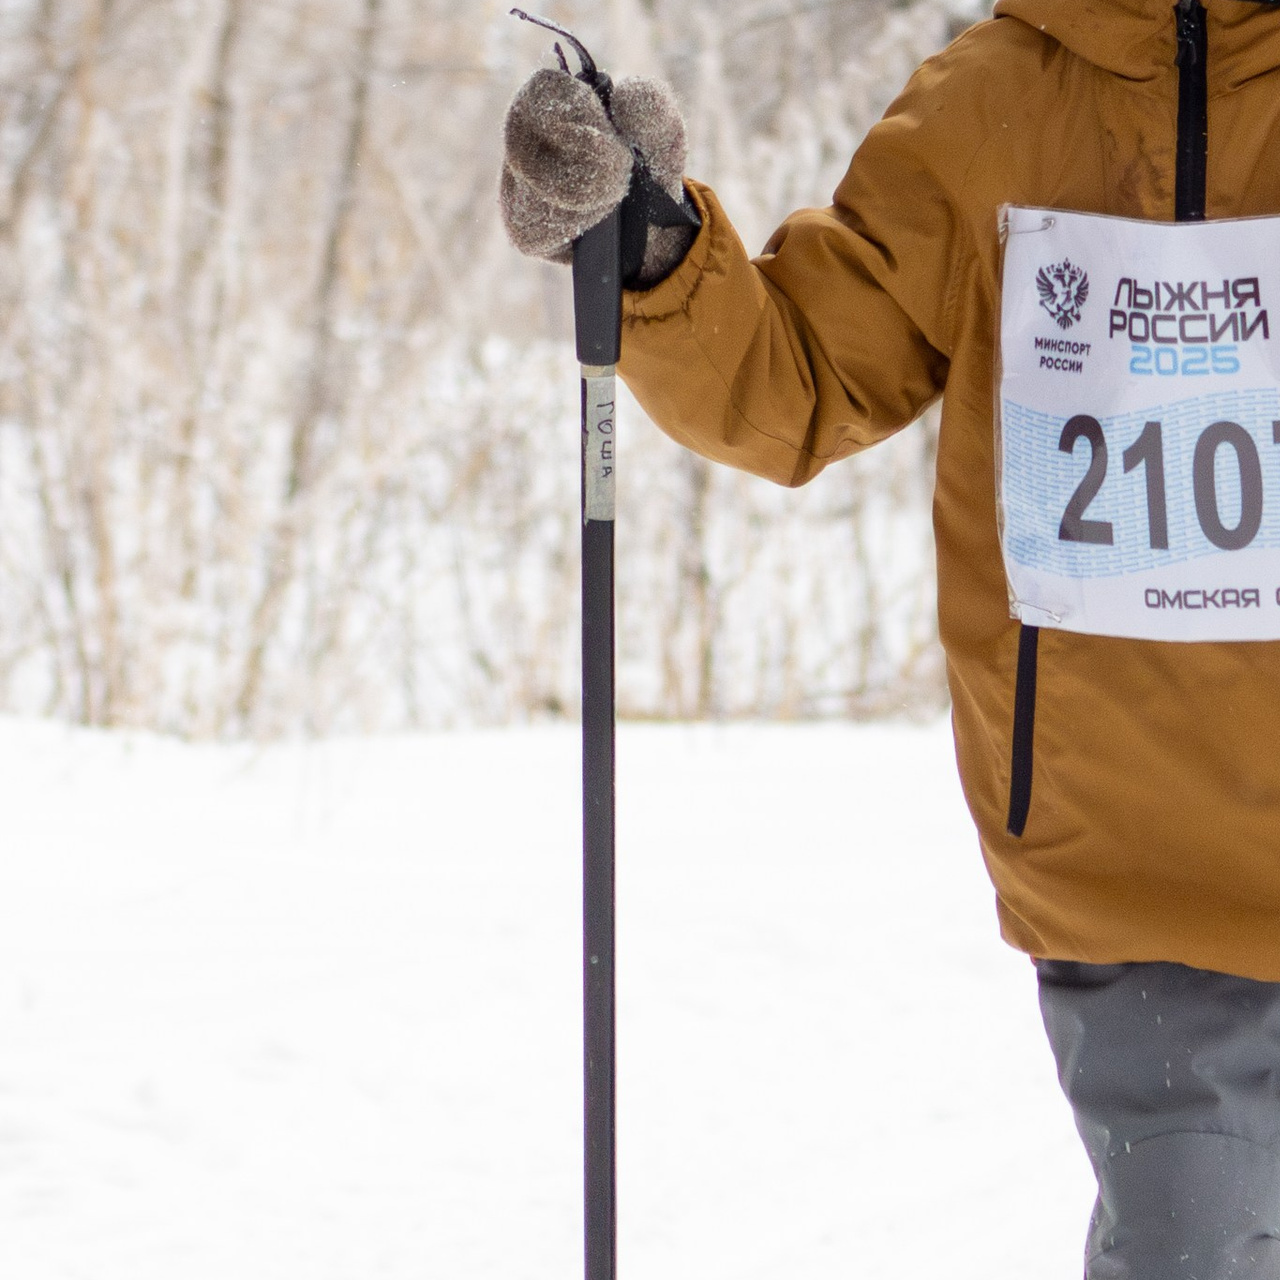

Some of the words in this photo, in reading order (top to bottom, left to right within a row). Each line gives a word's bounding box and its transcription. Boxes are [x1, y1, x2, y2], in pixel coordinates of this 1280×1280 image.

[1113, 276, 1262, 312] ЛЫЖНЯ
[1109, 308, 1271, 345] РОССИИ
[1034, 336, 1092, 357] МИНСПОРТ
[1129, 344, 1242, 377] 2025
[1039, 356, 1084, 375] РОССИИ
[1144, 587, 1261, 610] ОМСКАЯ
